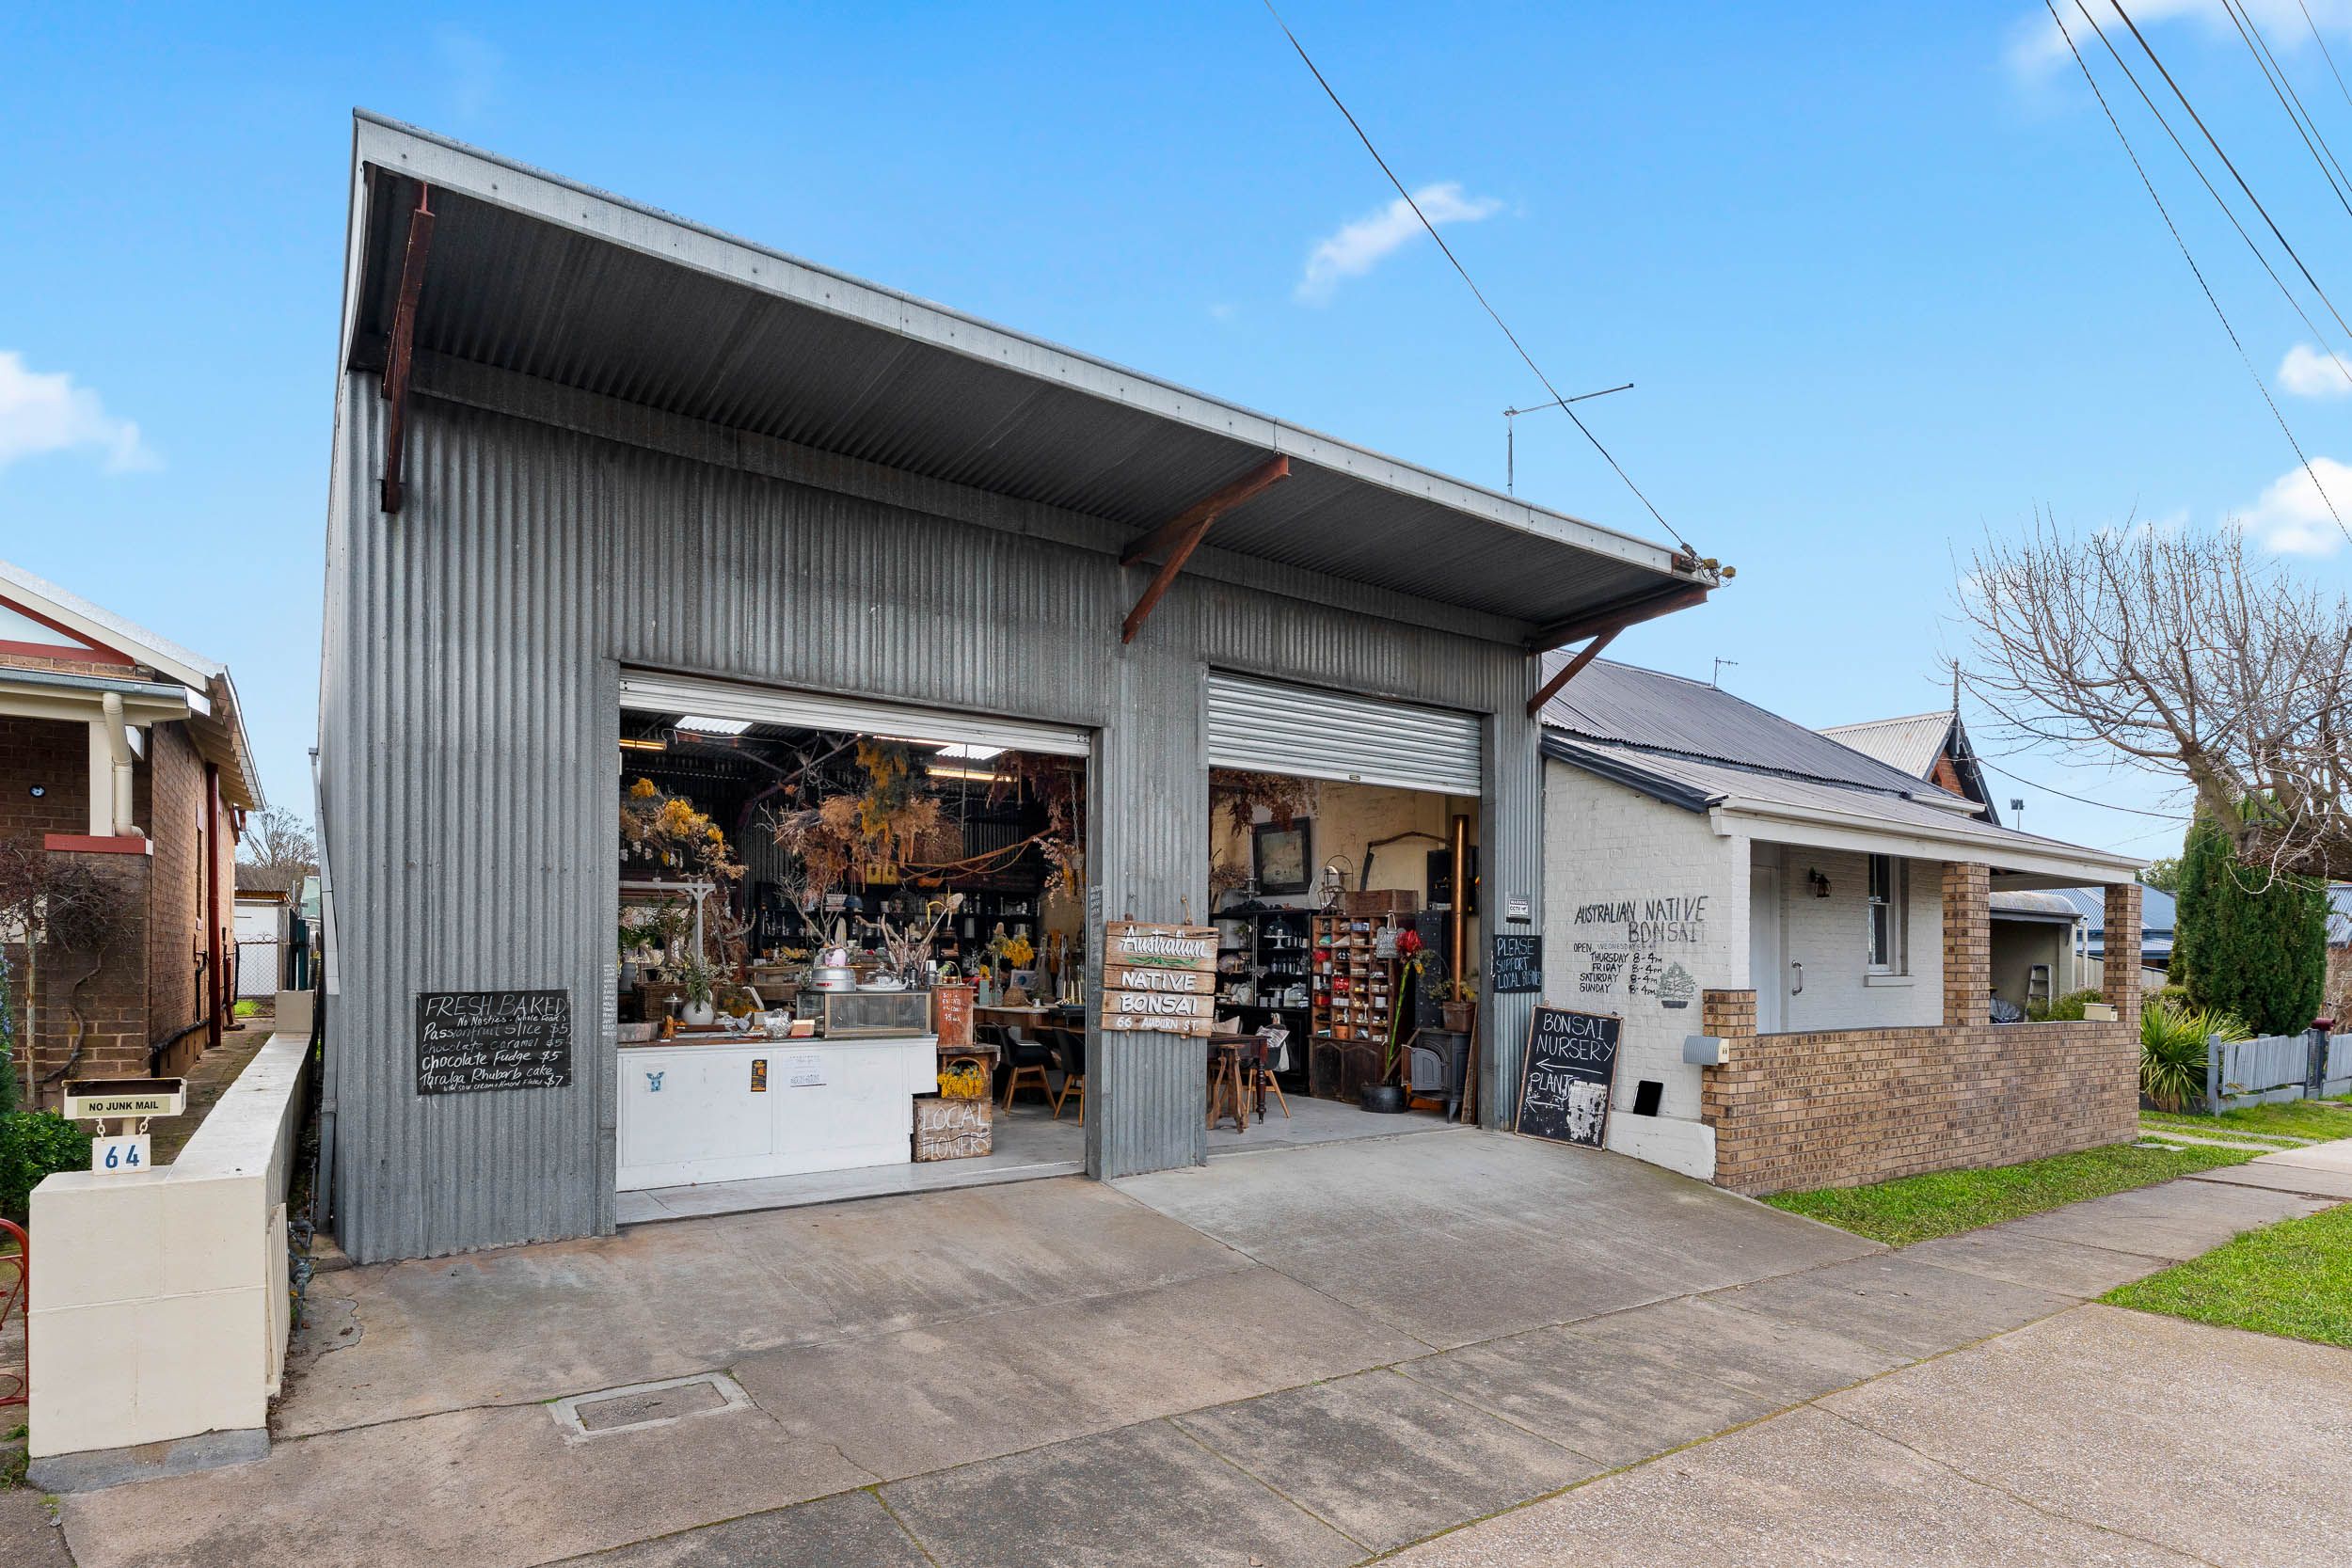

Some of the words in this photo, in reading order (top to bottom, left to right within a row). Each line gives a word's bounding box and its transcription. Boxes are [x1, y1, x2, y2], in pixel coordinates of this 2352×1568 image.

[1574, 899, 1636, 925] AUSTRALIAN
[1645, 895, 1708, 922] NATIVE
[1120, 925, 1206, 958] Australian
[1629, 921, 1697, 943] BONSAI
[1497, 937, 1536, 957] PLEASE
[1573, 942, 1592, 953] OPEN
[1496, 957, 1530, 973] SUPPORT
[1590, 951, 1629, 963] THURSDAY
[1592, 963, 1623, 973] FRIDAY
[1121, 971, 1197, 991] NATIVE
[1498, 972, 1520, 989] LOCAL
[1580, 973, 1618, 983] SATURDAY
[1580, 983, 1612, 993] SUNDAY
[426, 995, 492, 1017] FRESH
[498, 994, 567, 1017] BAKED
[1120, 995, 1198, 1015] BONSAI
[457, 1015, 469, 1026] No
[549, 1022, 570, 1037] $5
[1116, 1017, 1133, 1029] 66
[1141, 1018, 1179, 1030] AUBURN
[1543, 1013, 1609, 1040] BONSAI
[547, 1038, 564, 1048] $5
[1536, 1035, 1616, 1061] NURSERY
[493, 1049, 532, 1067] Fudge
[539, 1050, 563, 1064] $5
[471, 1068, 522, 1084] Rhubarb
[527, 1064, 554, 1077] cake
[545, 1075, 564, 1087] $7
[1530, 1071, 1581, 1101] PLANTS
[88, 1102, 103, 1112] NO
[106, 1101, 133, 1111] JUNK
[135, 1101, 159, 1110] MAIL
[922, 1102, 990, 1130] LOCAL
[923, 1132, 990, 1162] FLOWERS
[105, 1145, 140, 1169] 64
